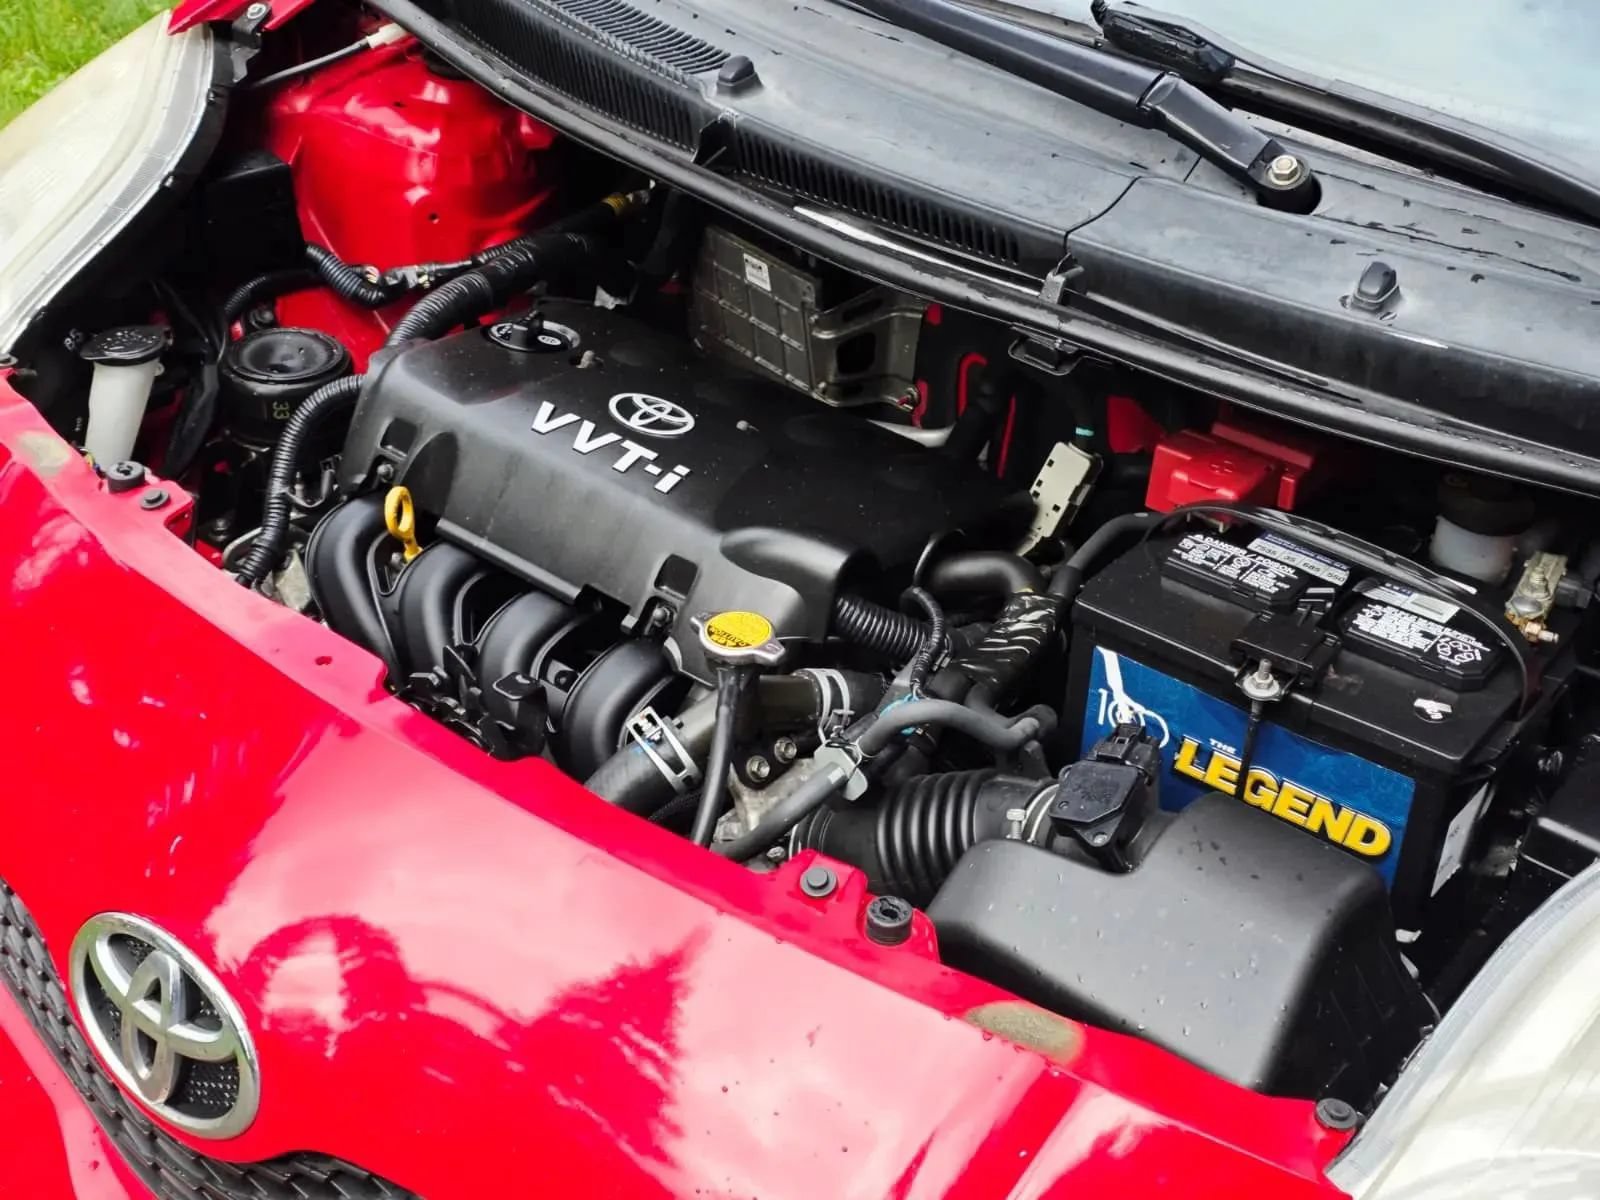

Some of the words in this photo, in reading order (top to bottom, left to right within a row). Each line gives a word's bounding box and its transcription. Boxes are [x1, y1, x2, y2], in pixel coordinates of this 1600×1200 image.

[532, 401, 691, 494] VVT-i
[1205, 537, 1248, 554] DANGER
[1255, 556, 1296, 574] POISON
[1210, 738, 1237, 754] THE
[1174, 736, 1392, 856] LEGEND
